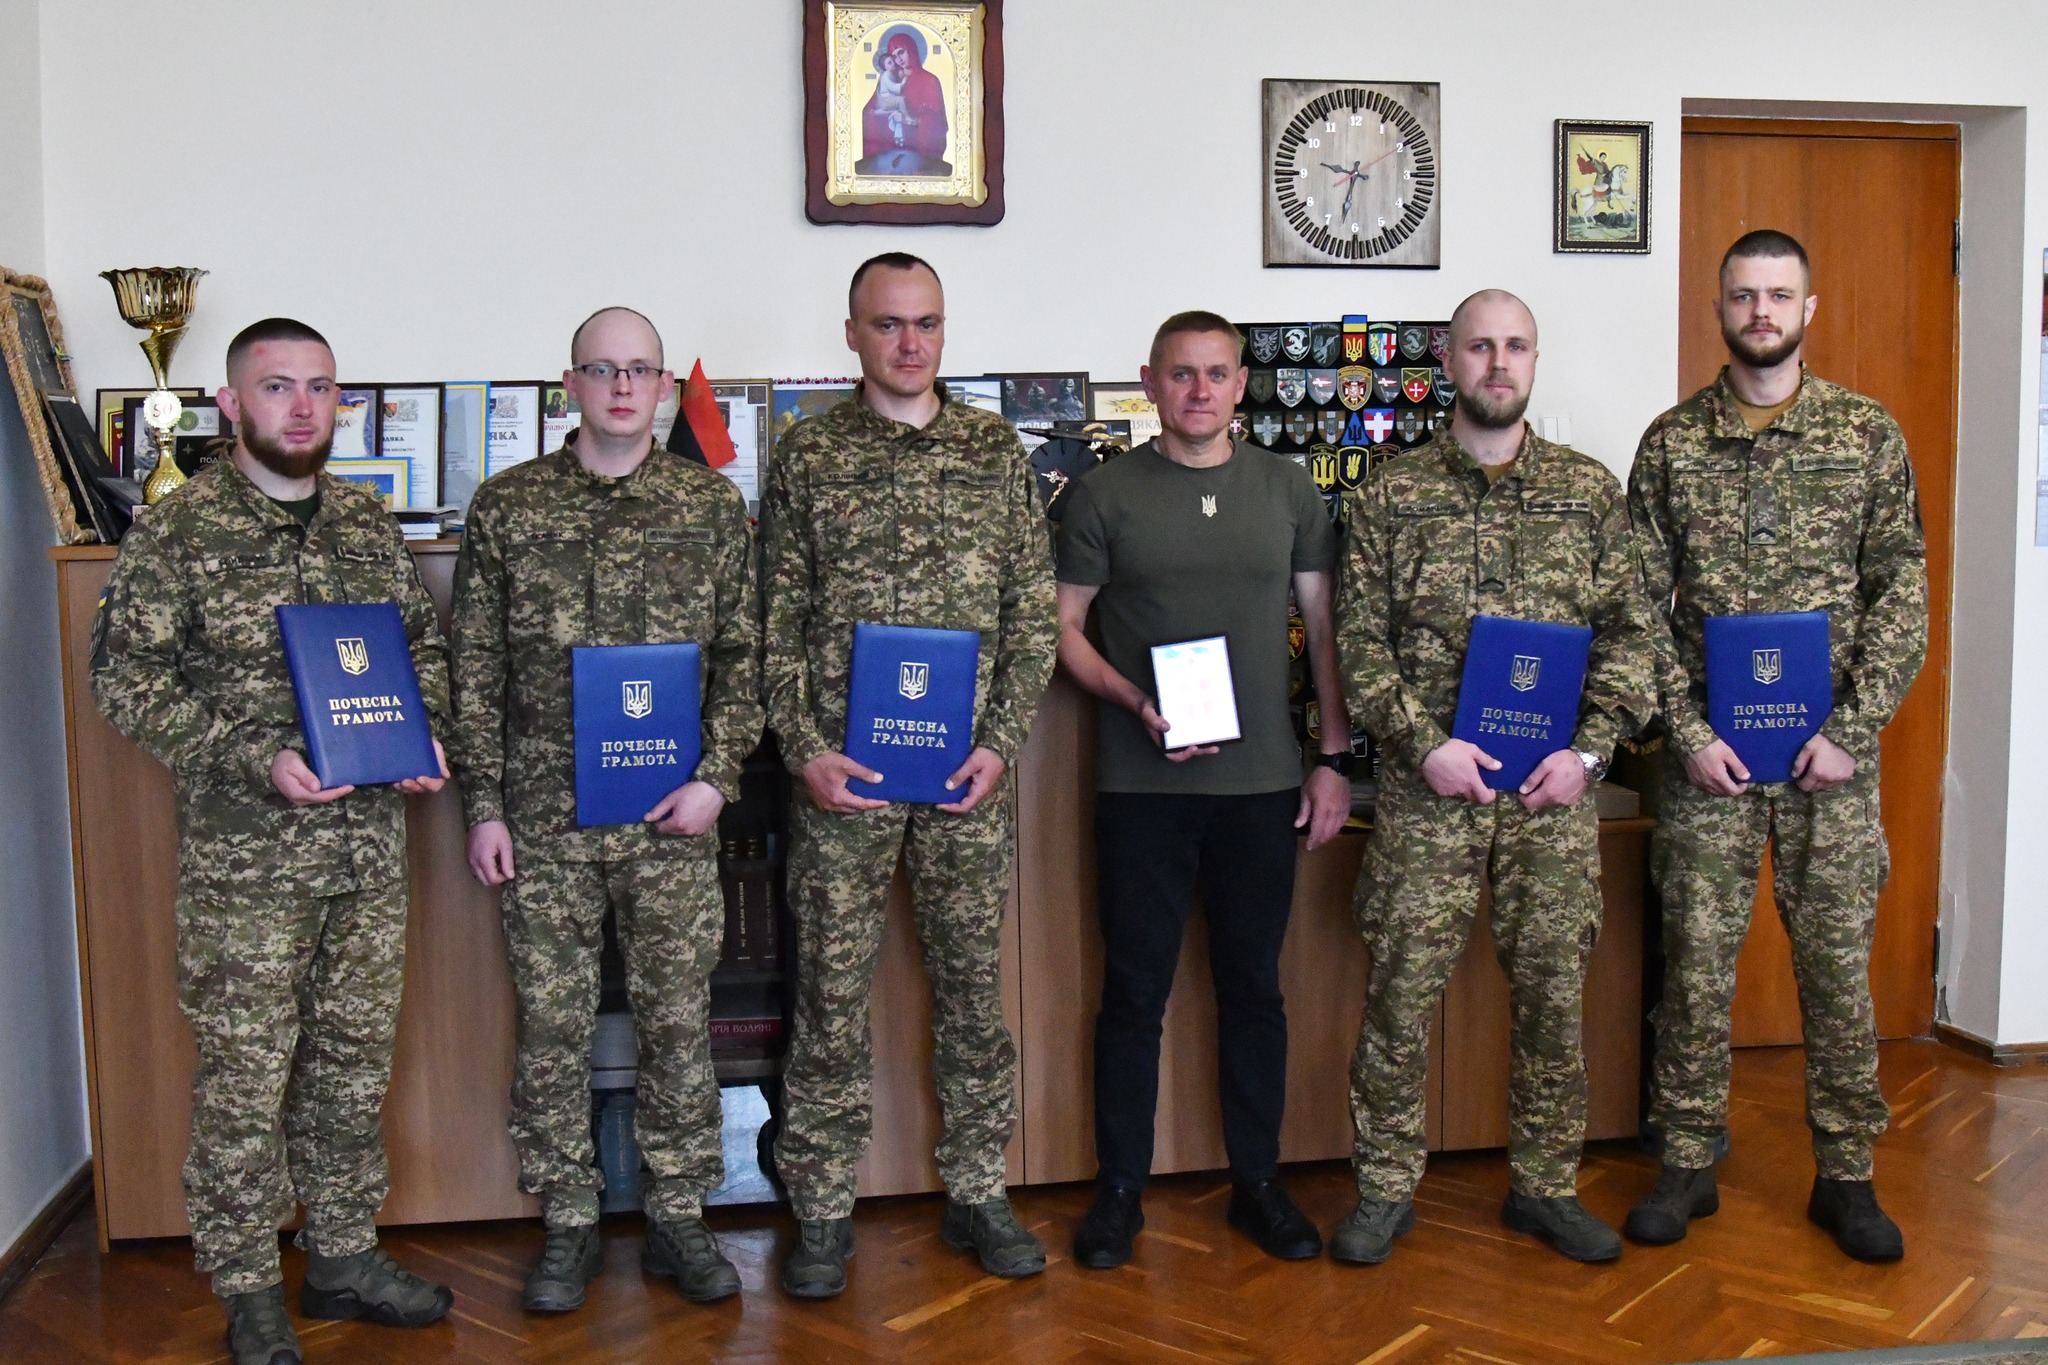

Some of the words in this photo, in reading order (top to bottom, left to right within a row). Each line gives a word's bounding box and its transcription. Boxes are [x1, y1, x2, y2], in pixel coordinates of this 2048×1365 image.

[1350, 115, 1363, 127] 12
[1325, 123, 1336, 133] 11
[1379, 124, 1385, 134] 1
[1308, 138, 1320, 148] 10
[1396, 143, 1404, 153] 2
[1300, 169, 1308, 179] 9
[1403, 170, 1411, 180] 3
[1306, 196, 1314, 207] 8
[1395, 198, 1403, 208] 4
[1325, 214, 1332, 225] 7
[1378, 216, 1386, 227] 5
[1351, 222, 1359, 233] 6
[152, 402, 173, 418] 50
[329, 695, 403, 711] ПОЧЕСНА
[1733, 703, 1809, 716] ПОЧЕСНА
[331, 710, 405, 726] ГРАМОТА
[1481, 707, 1553, 726] ПОЧЕСНА
[873, 717, 948, 734] ПОЧЕСНА
[1733, 717, 1808, 730] ГРАМОТА
[1478, 721, 1549, 740] ГРАМОТА
[601, 738, 678, 753] ПОЧЕСНА
[871, 732, 946, 748] ГРАМОТА
[601, 753, 677, 768] ГРАМОТА
